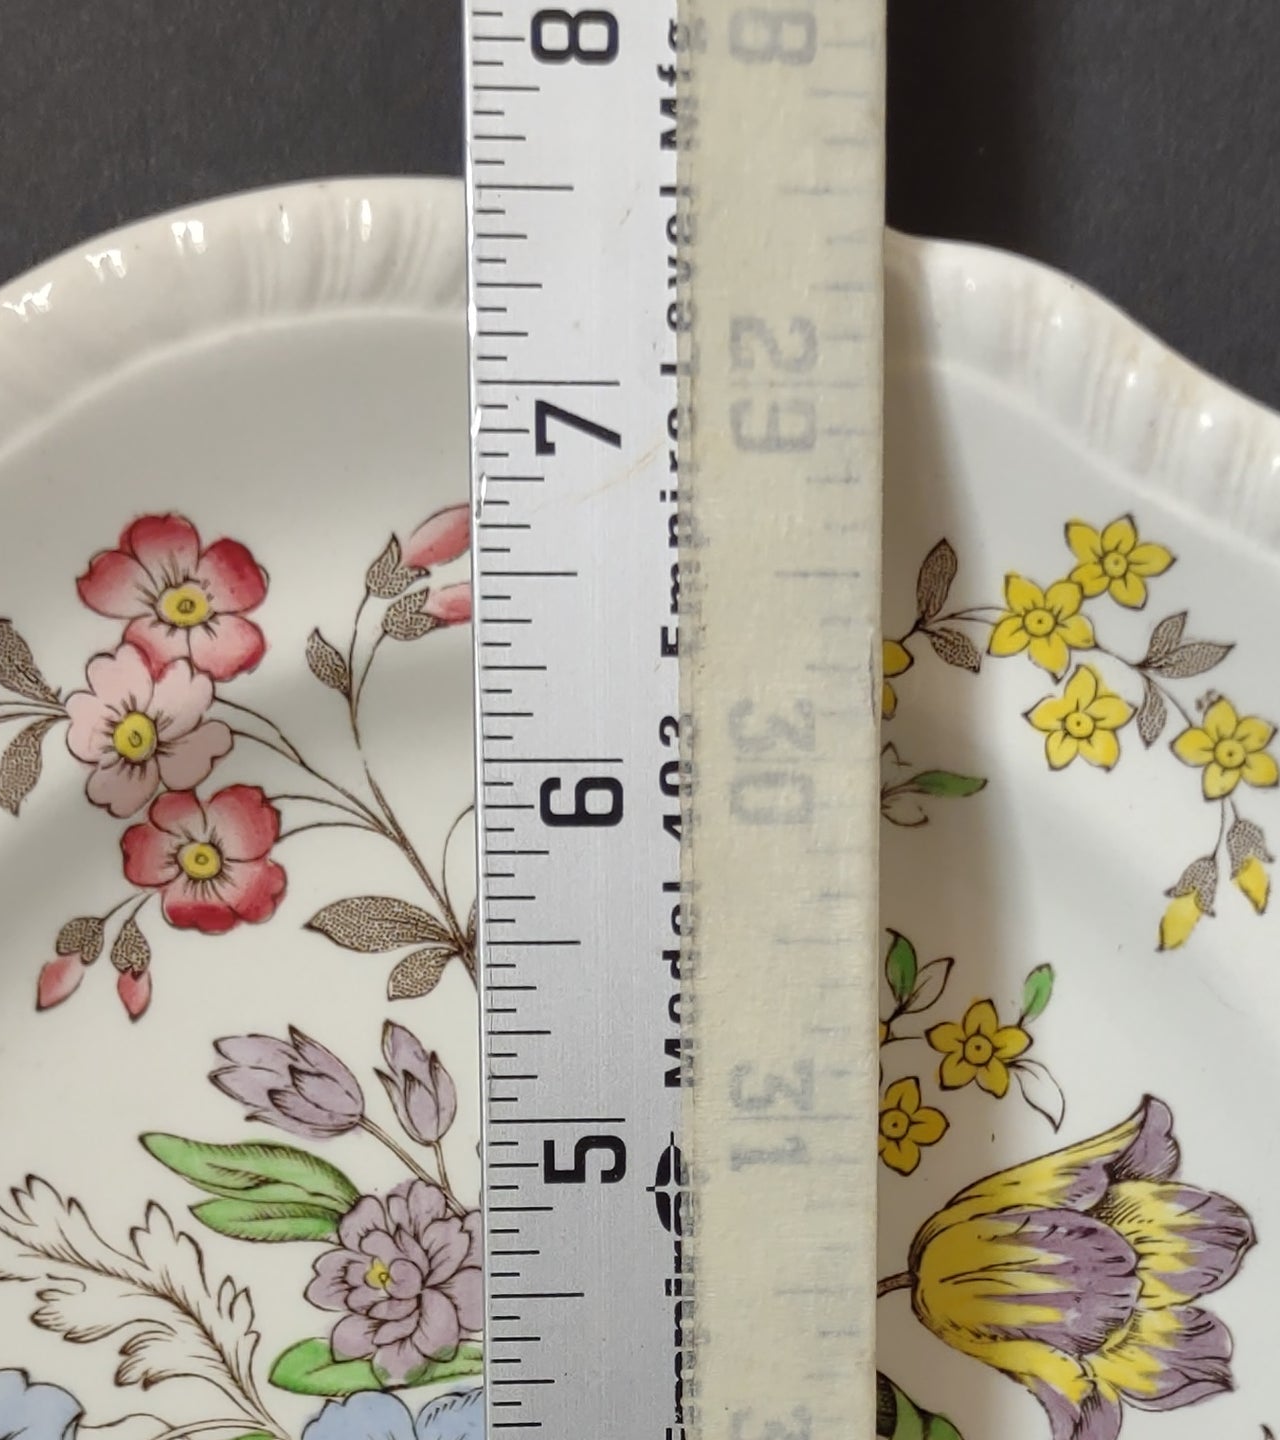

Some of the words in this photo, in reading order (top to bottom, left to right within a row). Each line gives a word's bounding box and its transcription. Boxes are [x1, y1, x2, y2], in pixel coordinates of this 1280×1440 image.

[531, 9, 620, 66] 8
[728, 315, 819, 454] 29
[534, 399, 622, 457] 7
[728, 697, 817, 826] 30
[539, 776, 624, 828] 6
[728, 1057, 815, 1172] 31
[543, 1134, 627, 1184] 5
